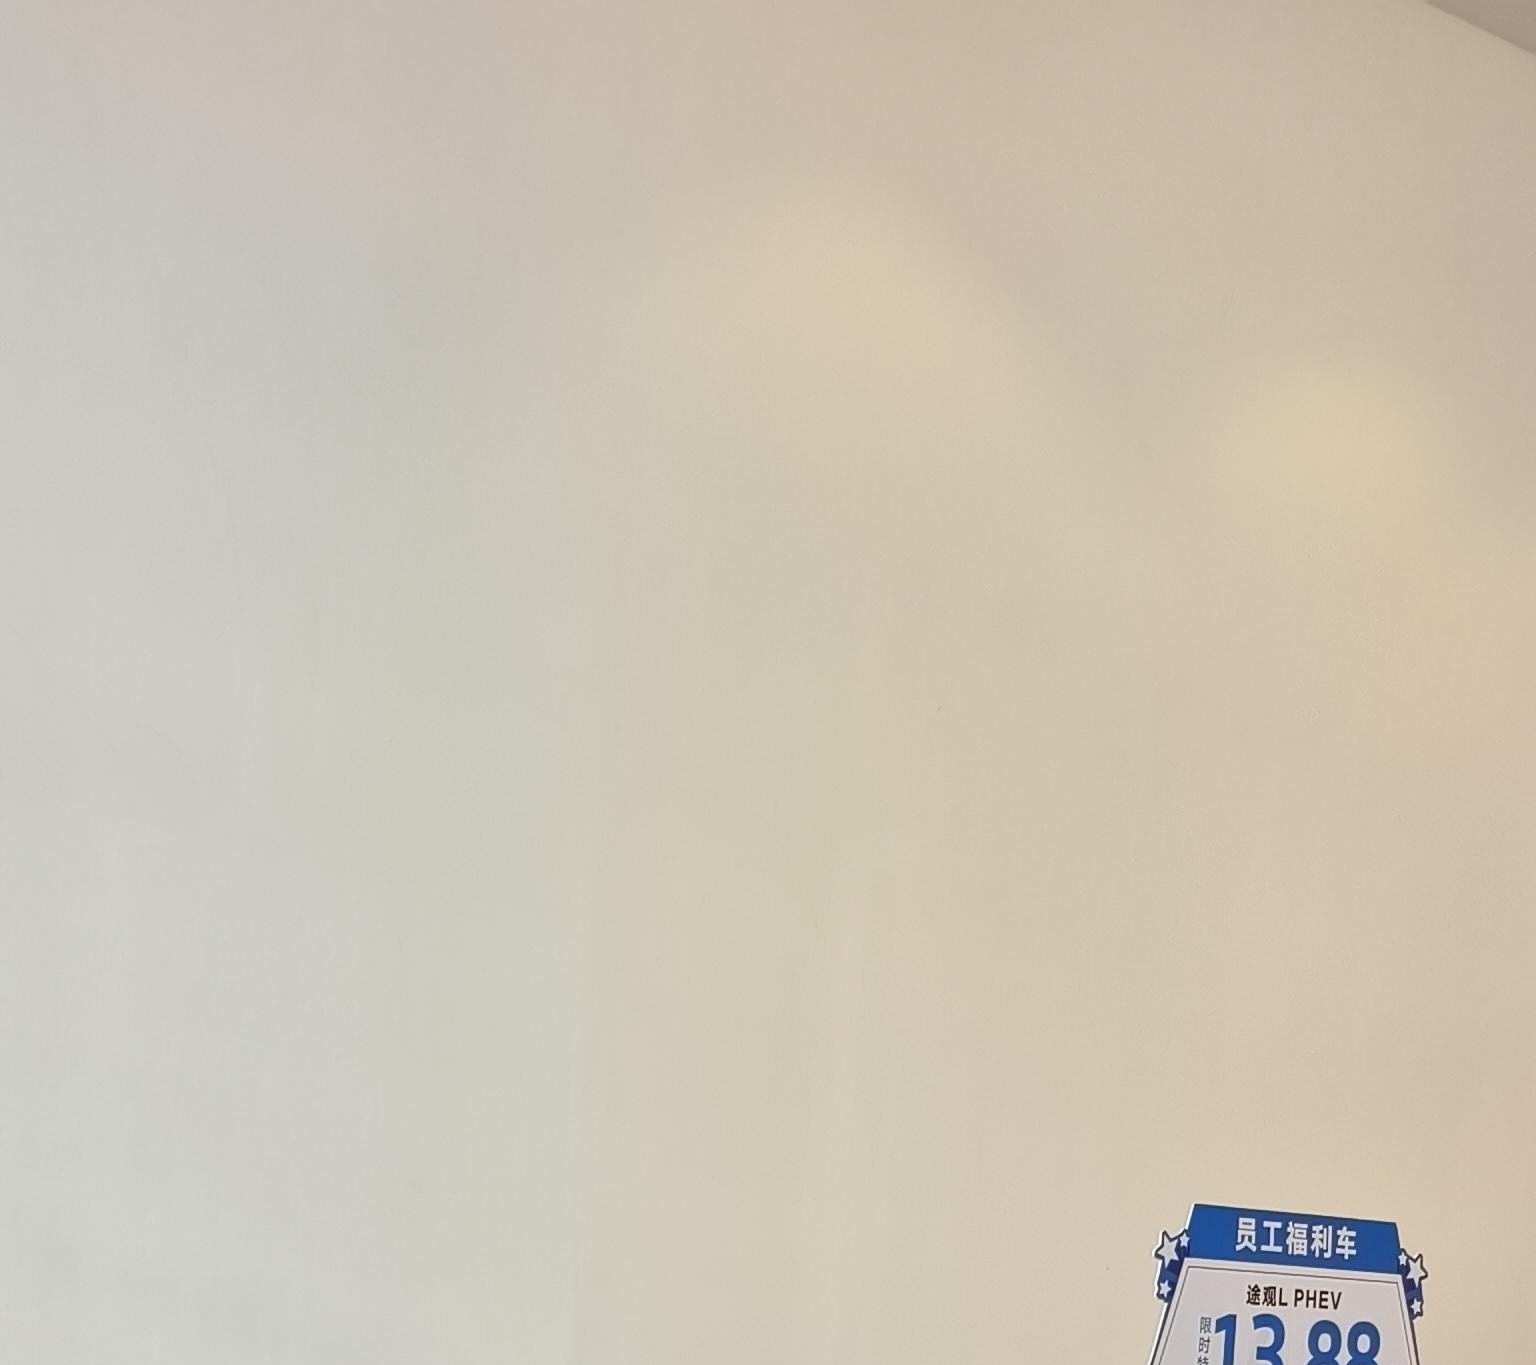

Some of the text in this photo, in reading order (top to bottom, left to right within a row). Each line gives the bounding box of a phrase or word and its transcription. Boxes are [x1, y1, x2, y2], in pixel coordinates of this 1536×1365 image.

[1235, 1217, 1357, 1260] 员工福利车
[1246, 1284, 1342, 1310] 途观L PHEV
